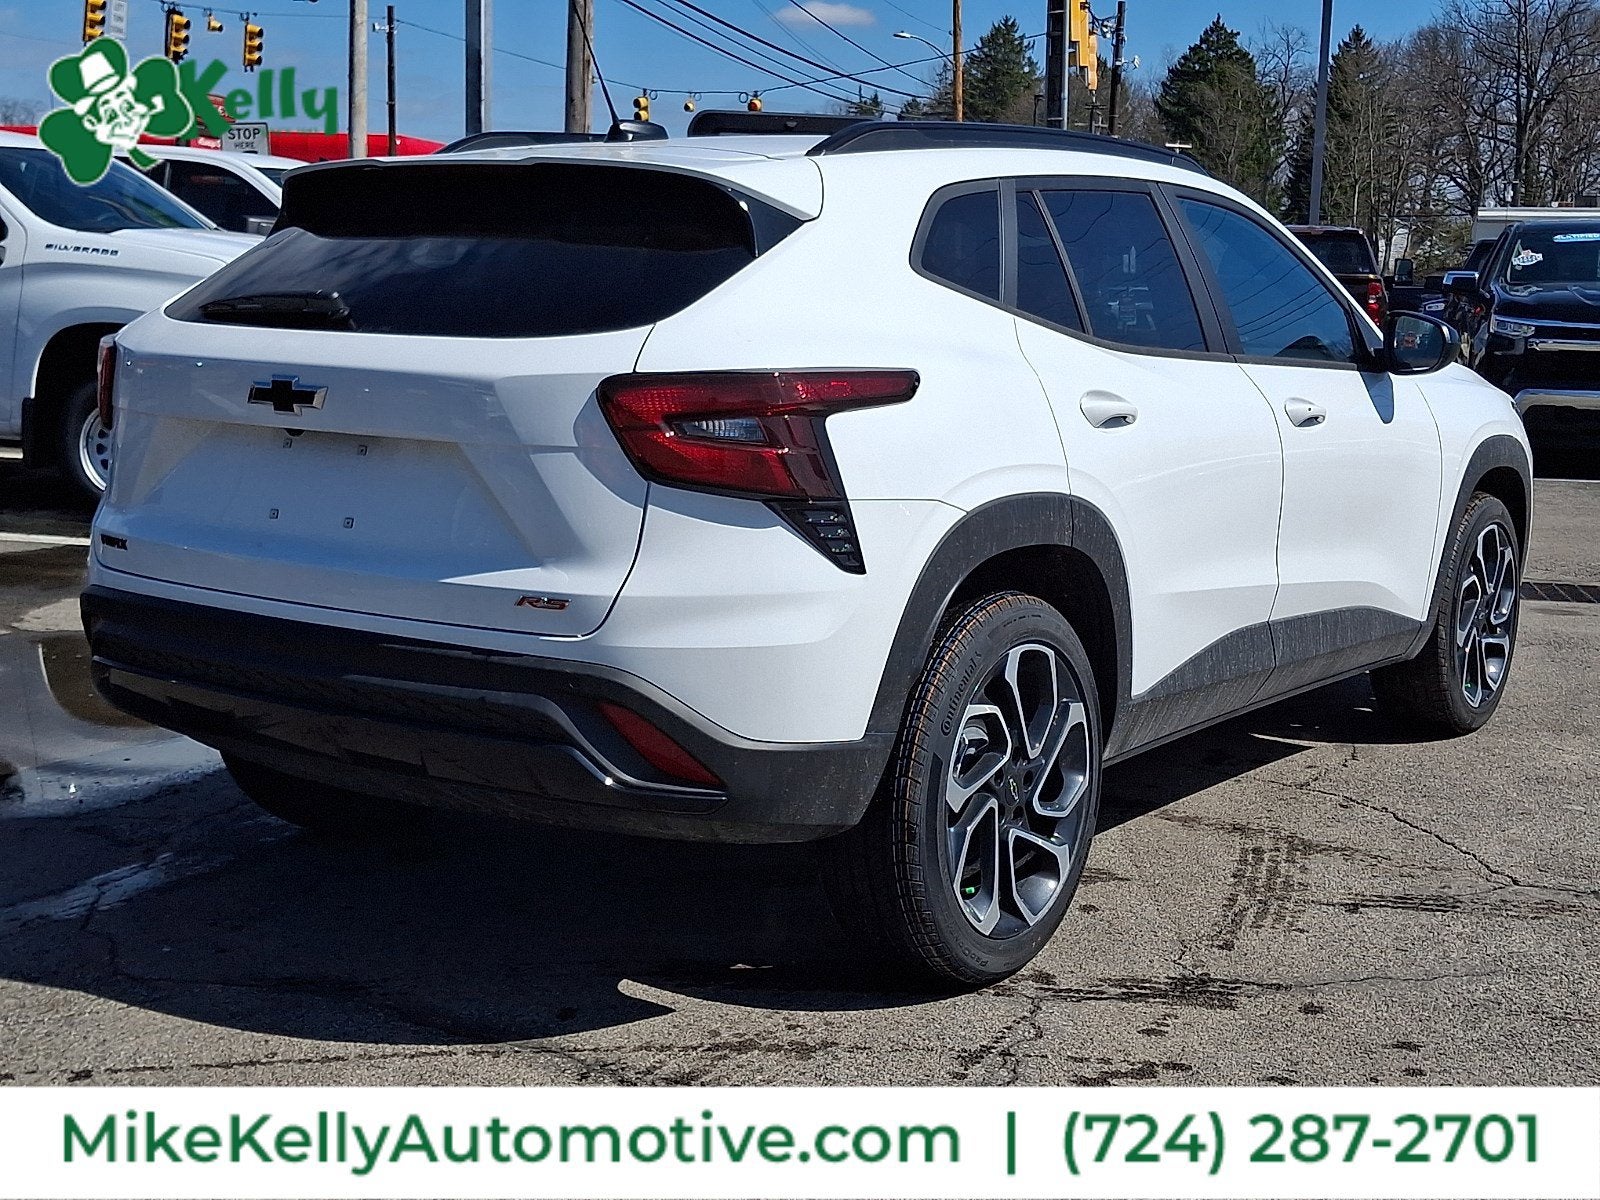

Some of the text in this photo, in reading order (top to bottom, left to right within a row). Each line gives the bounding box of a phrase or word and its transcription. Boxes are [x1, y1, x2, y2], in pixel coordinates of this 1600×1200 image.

[228, 127, 260, 141] STOP
[233, 141, 255, 150] HERE
[44, 243, 119, 256] SILVERADO
[514, 595, 572, 612] RS
[940, 657, 978, 737] Continental
